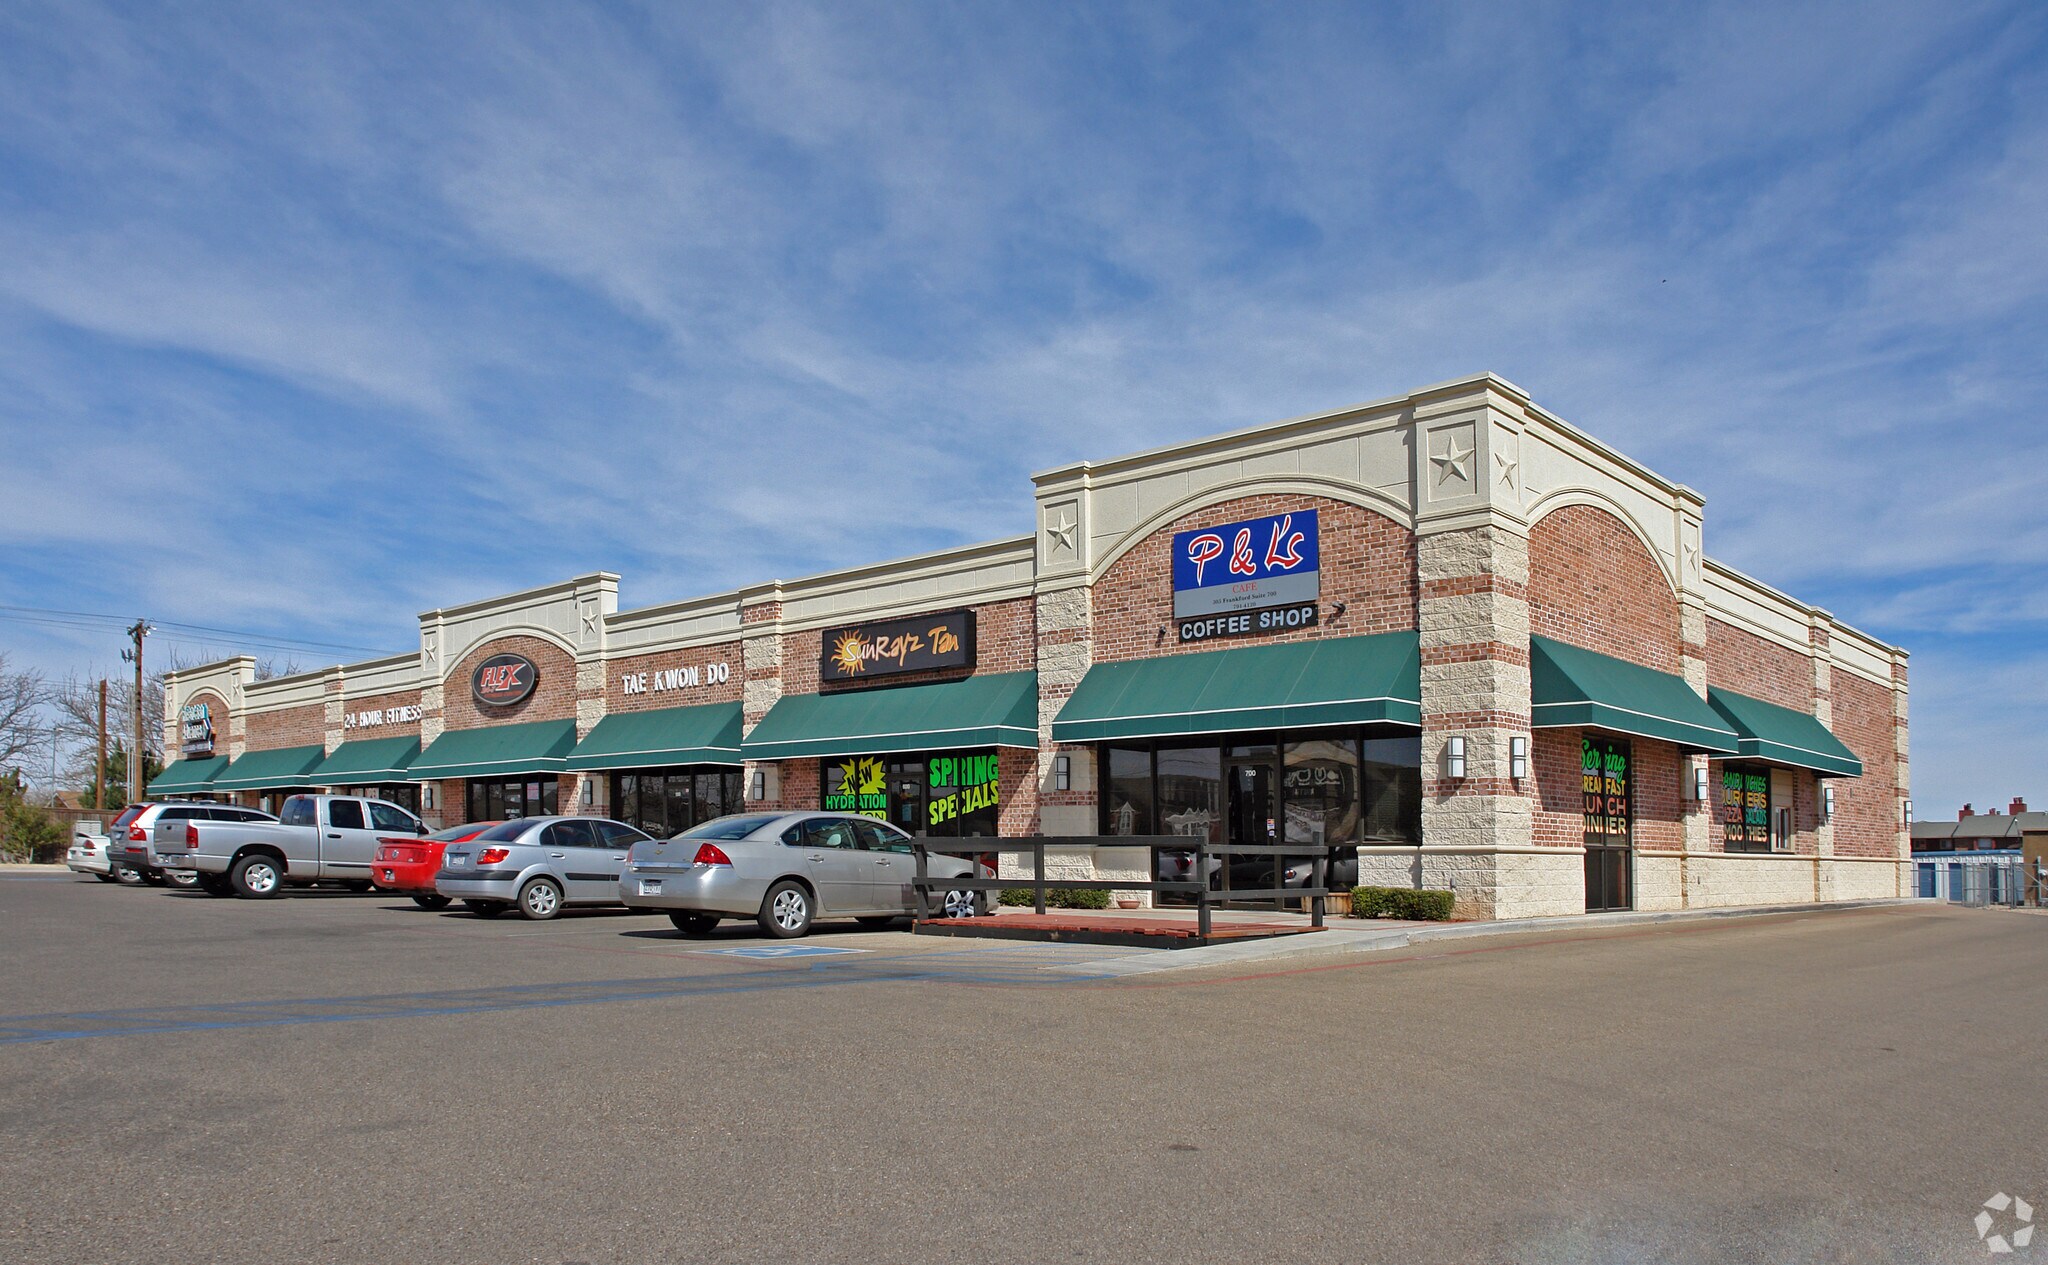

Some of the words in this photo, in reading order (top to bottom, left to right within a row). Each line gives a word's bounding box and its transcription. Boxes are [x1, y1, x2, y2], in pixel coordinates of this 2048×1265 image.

[1188, 534, 1224, 587] P
[1229, 528, 1257, 576] &
[1232, 582, 1258, 594] CAFE
[1181, 615, 1251, 639] COFFEE
[1259, 607, 1313, 628] SHOP
[928, 625, 959, 655] Tan
[480, 663, 527, 692] FLEX
[622, 672, 647, 694] TAE
[654, 666, 699, 691] KWON
[707, 662, 730, 685] DO
[344, 713, 356, 728] 24
[359, 709, 383, 727] HOUR
[386, 703, 423, 724] FITNESS
[1244, 769, 1257, 777] 700
[1582, 775, 1626, 796] REAFAST
[826, 794, 887, 809] HYDRATION
[1583, 796, 1626, 816] UNCH
[1723, 789, 1767, 810] URERS
[1723, 807, 1744, 823] IZZA
[1724, 824, 1768, 843] MOOTHIES
